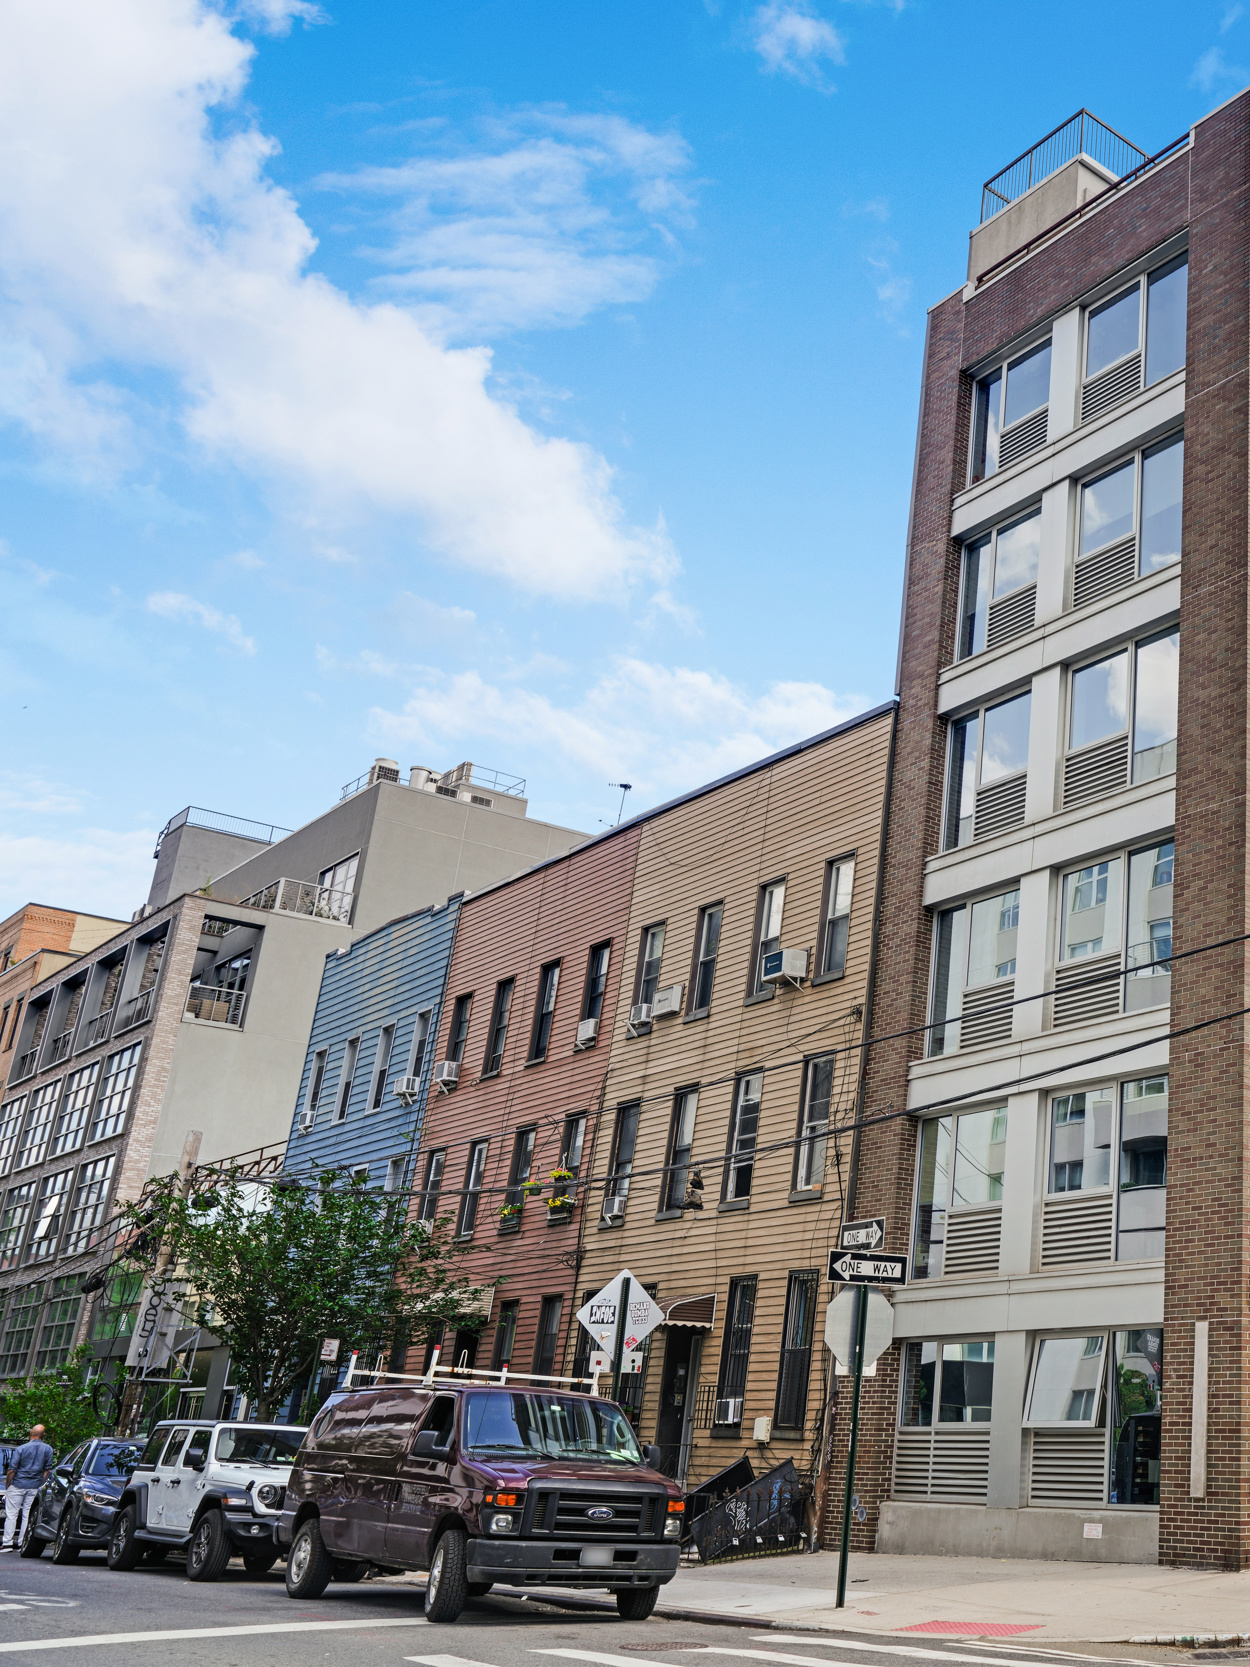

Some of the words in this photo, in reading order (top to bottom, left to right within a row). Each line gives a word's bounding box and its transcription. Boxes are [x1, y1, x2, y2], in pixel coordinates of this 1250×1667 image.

[846, 1231, 860, 1244] ONE
[865, 1228, 879, 1241] WAY
[840, 1260, 863, 1274] ONE
[873, 1263, 897, 1276] WAY
